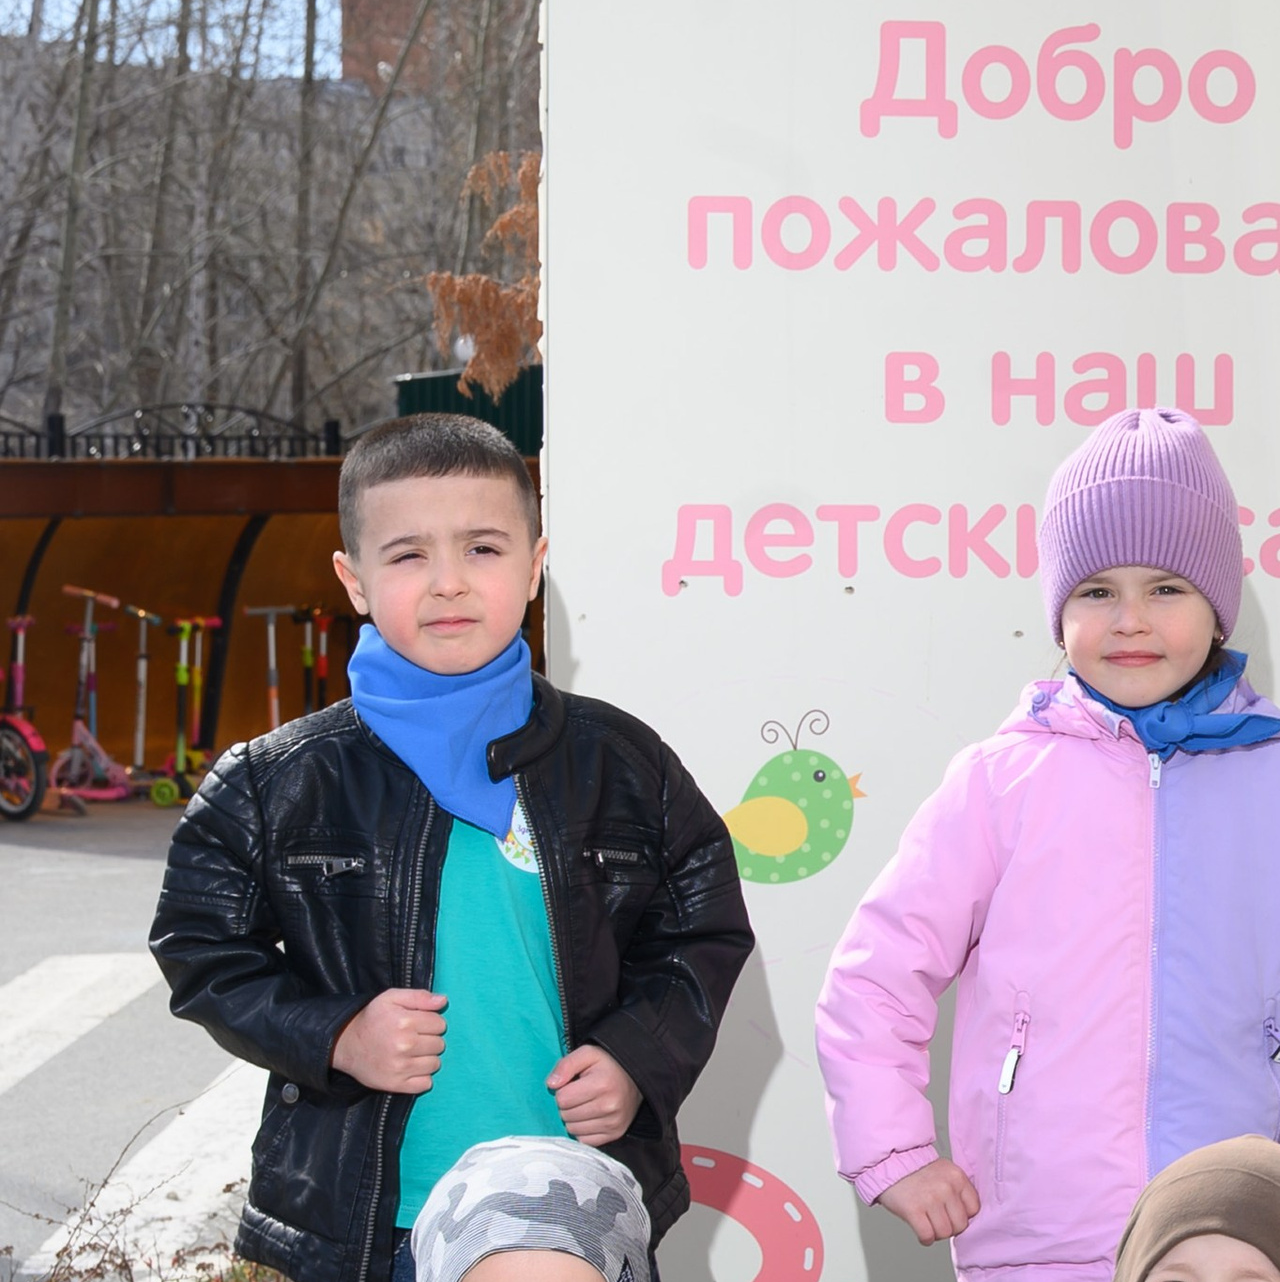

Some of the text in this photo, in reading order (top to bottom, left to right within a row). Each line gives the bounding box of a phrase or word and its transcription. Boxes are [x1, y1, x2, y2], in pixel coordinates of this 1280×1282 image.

[860, 19, 1256, 150] Добро
[885, 352, 1234, 426] в наш
[662, 504, 1040, 596] детск
